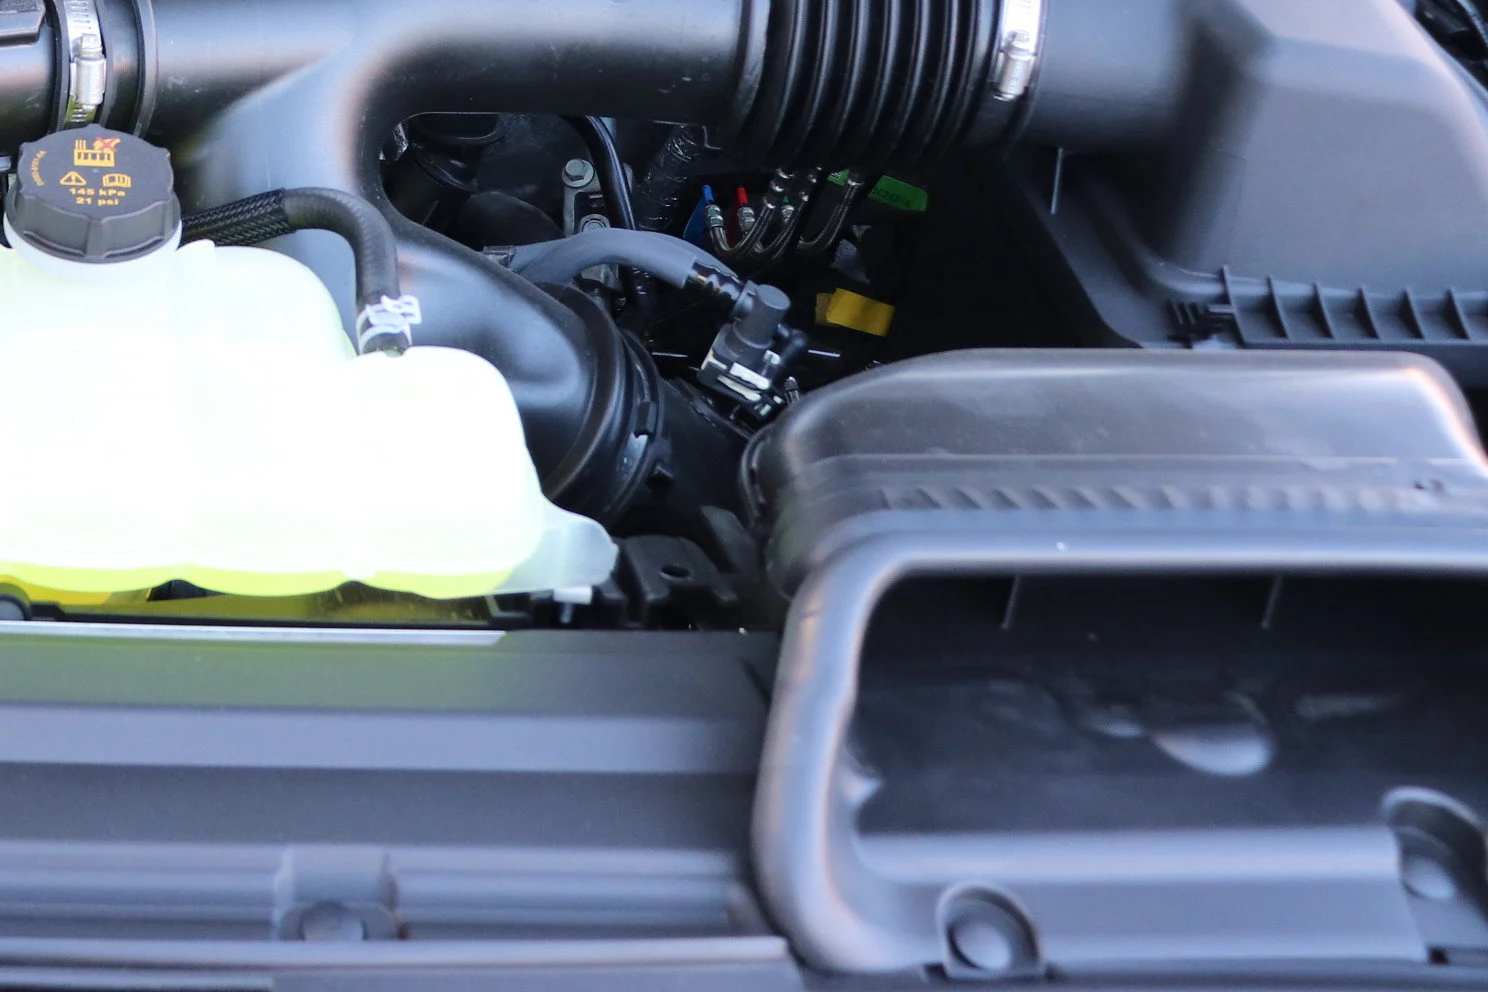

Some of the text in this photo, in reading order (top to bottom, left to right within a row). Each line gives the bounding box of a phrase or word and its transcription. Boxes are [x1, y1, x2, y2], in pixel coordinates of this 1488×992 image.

[69, 188, 126, 197] 145 kPa
[75, 196, 119, 207] 21 psi
